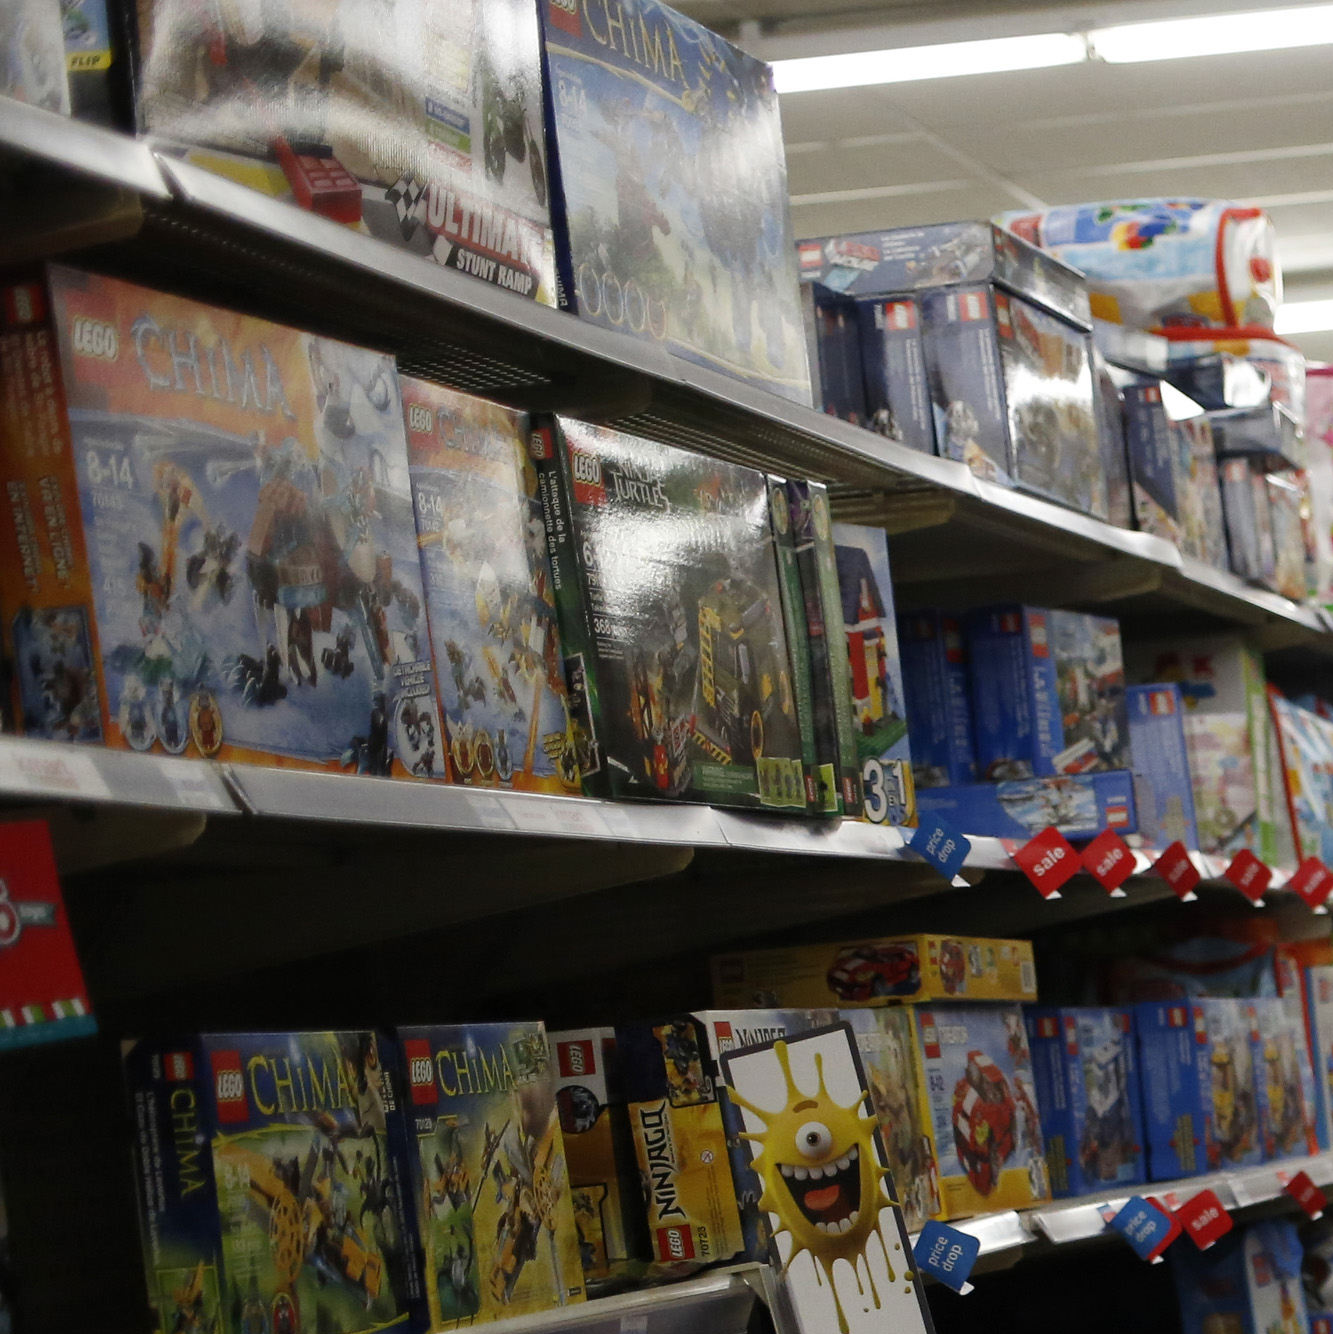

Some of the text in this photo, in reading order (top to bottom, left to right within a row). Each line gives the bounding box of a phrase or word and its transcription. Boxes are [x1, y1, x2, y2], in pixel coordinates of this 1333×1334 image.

[583, 0, 690, 89] CHIMA
[71, 55, 101, 66] FLIP
[456, 250, 533, 295] STUNT RAMP
[72, 317, 118, 359] LEGO
[132, 313, 297, 421] CHIMA
[409, 402, 433, 433] LEGO
[531, 431, 544, 459] LEGO
[87, 451, 133, 489] 8-14
[572, 452, 602, 486] LEGO
[418, 491, 442, 514] 8-14
[549, 471, 562, 516] L'attaque
[611, 470, 671, 512] TURTLES
[538, 473, 553, 528] camionnette
[551, 549, 562, 591] tortues
[594, 619, 611, 634] 368
[925, 828, 945, 855] price
[937, 838, 956, 863] drop
[1032, 846, 1066, 877] sale
[1096, 847, 1124, 877] sale
[410, 1056, 434, 1086] LEGO
[436, 1044, 520, 1098] CHIMA
[569, 1044, 585, 1074] LEGO
[216, 1070, 246, 1102] LEGO
[248, 1047, 357, 1115] CHIMA
[170, 1088, 207, 1200] CHIMA
[641, 1100, 688, 1221] NINJAGO
[1125, 1211, 1148, 1235] price
[1135, 1219, 1157, 1242] drop
[1191, 1207, 1219, 1232] sale
[659, 1229, 682, 1259] LEGO
[700, 1226, 711, 1258] 70723
[928, 1235, 949, 1268] price
[942, 1244, 963, 1273] drop
